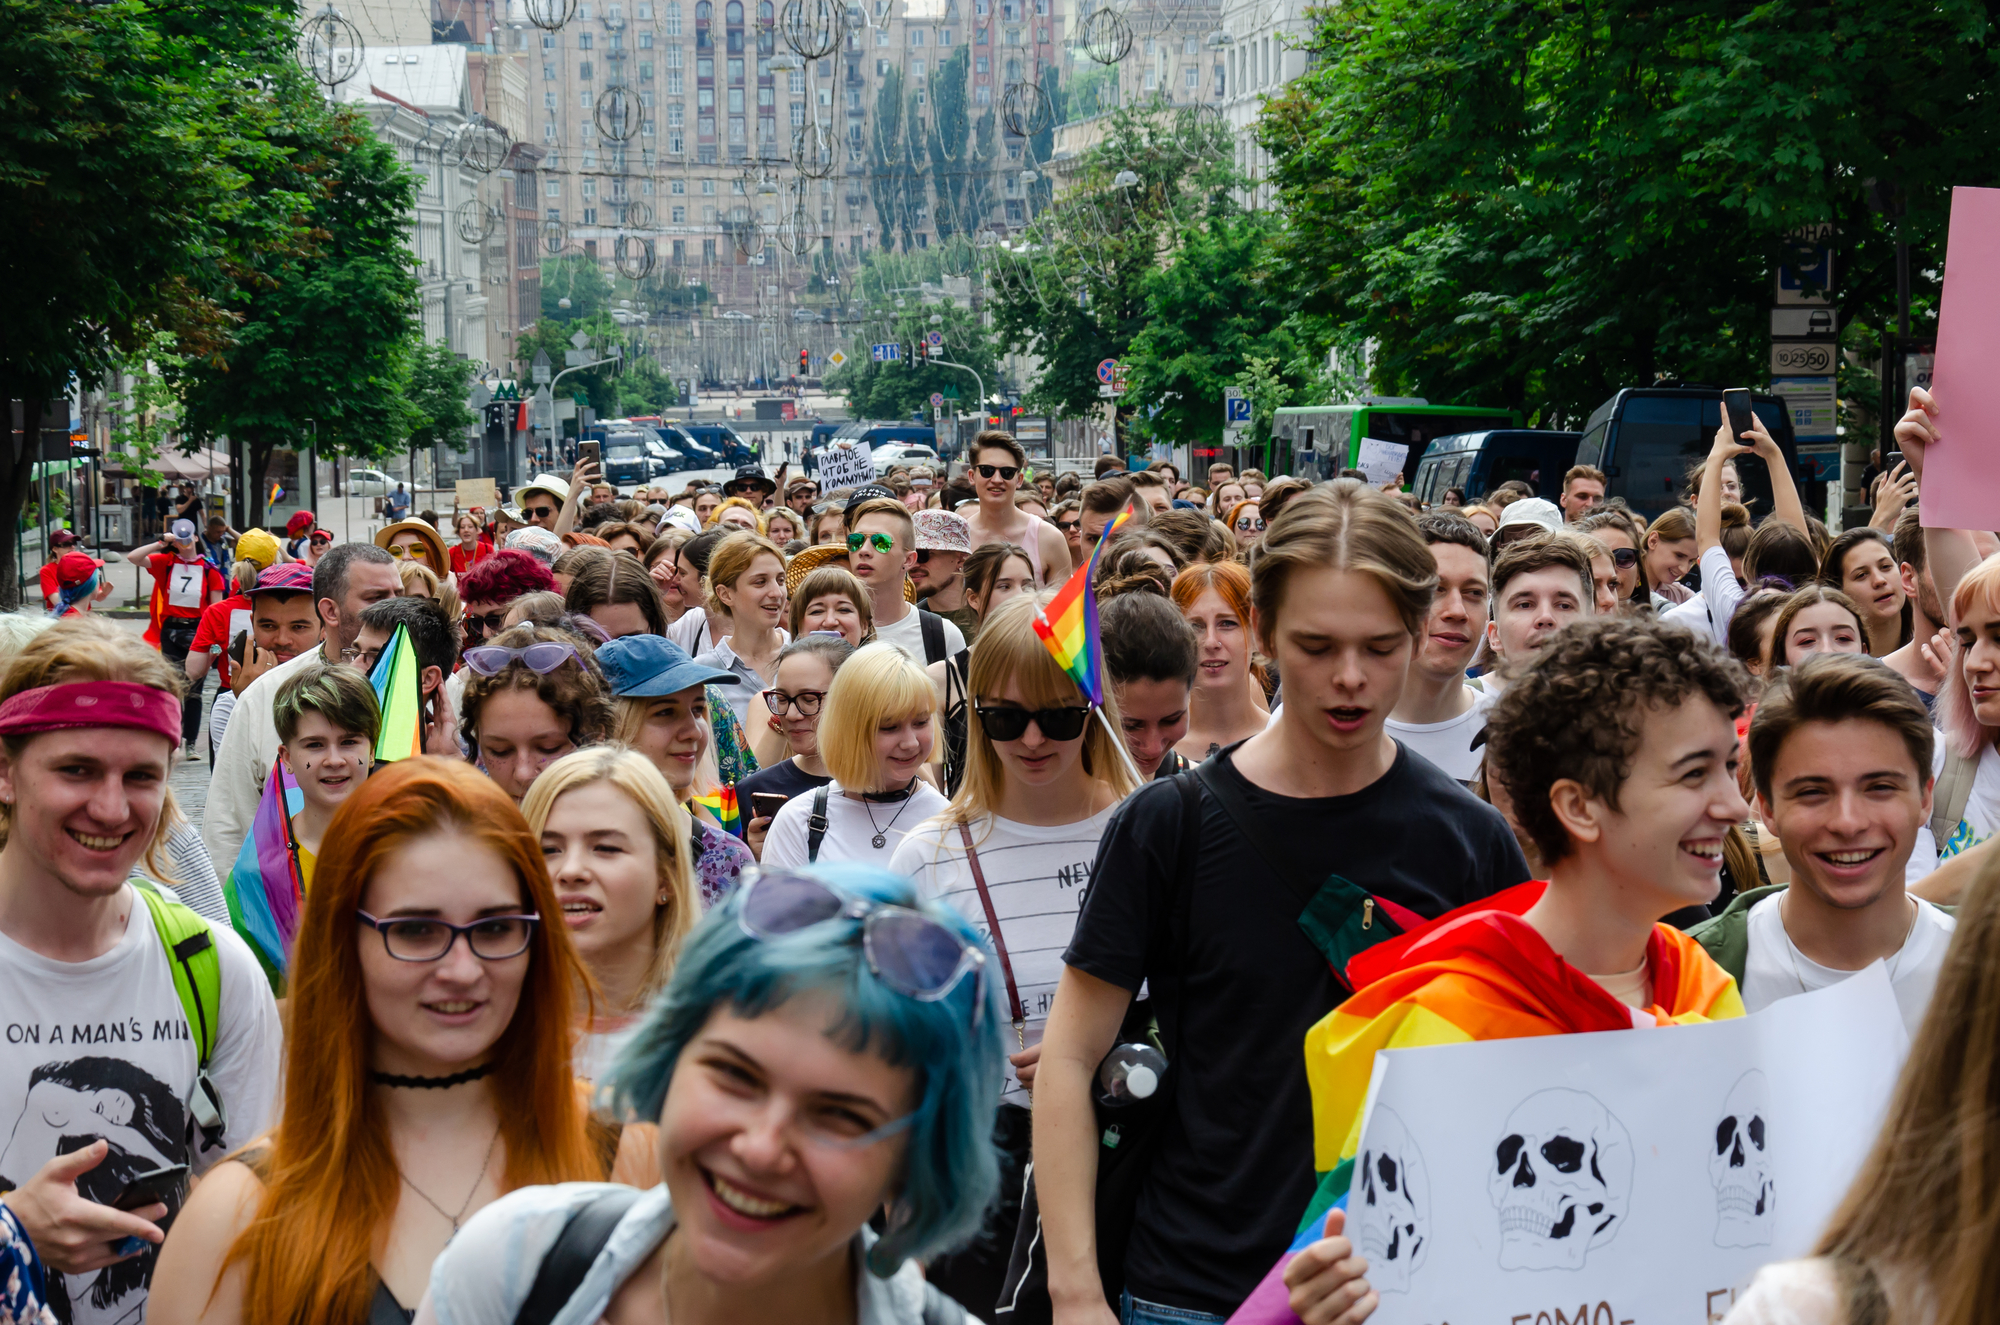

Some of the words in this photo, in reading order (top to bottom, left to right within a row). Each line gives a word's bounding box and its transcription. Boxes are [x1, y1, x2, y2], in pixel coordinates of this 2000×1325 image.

[820, 446, 861, 467] ГЛАВНОЕ
[822, 462, 850, 479] ЧТОБ
[854, 457, 868, 472] НЕ
[825, 466, 875, 492] КОММУНИСТ
[180, 575, 193, 594] 7
[6, 1023, 40, 1044] ON
[48, 1024, 64, 1045] A
[71, 1016, 143, 1045] MAN'S
[152, 1019, 189, 1042] MIN
